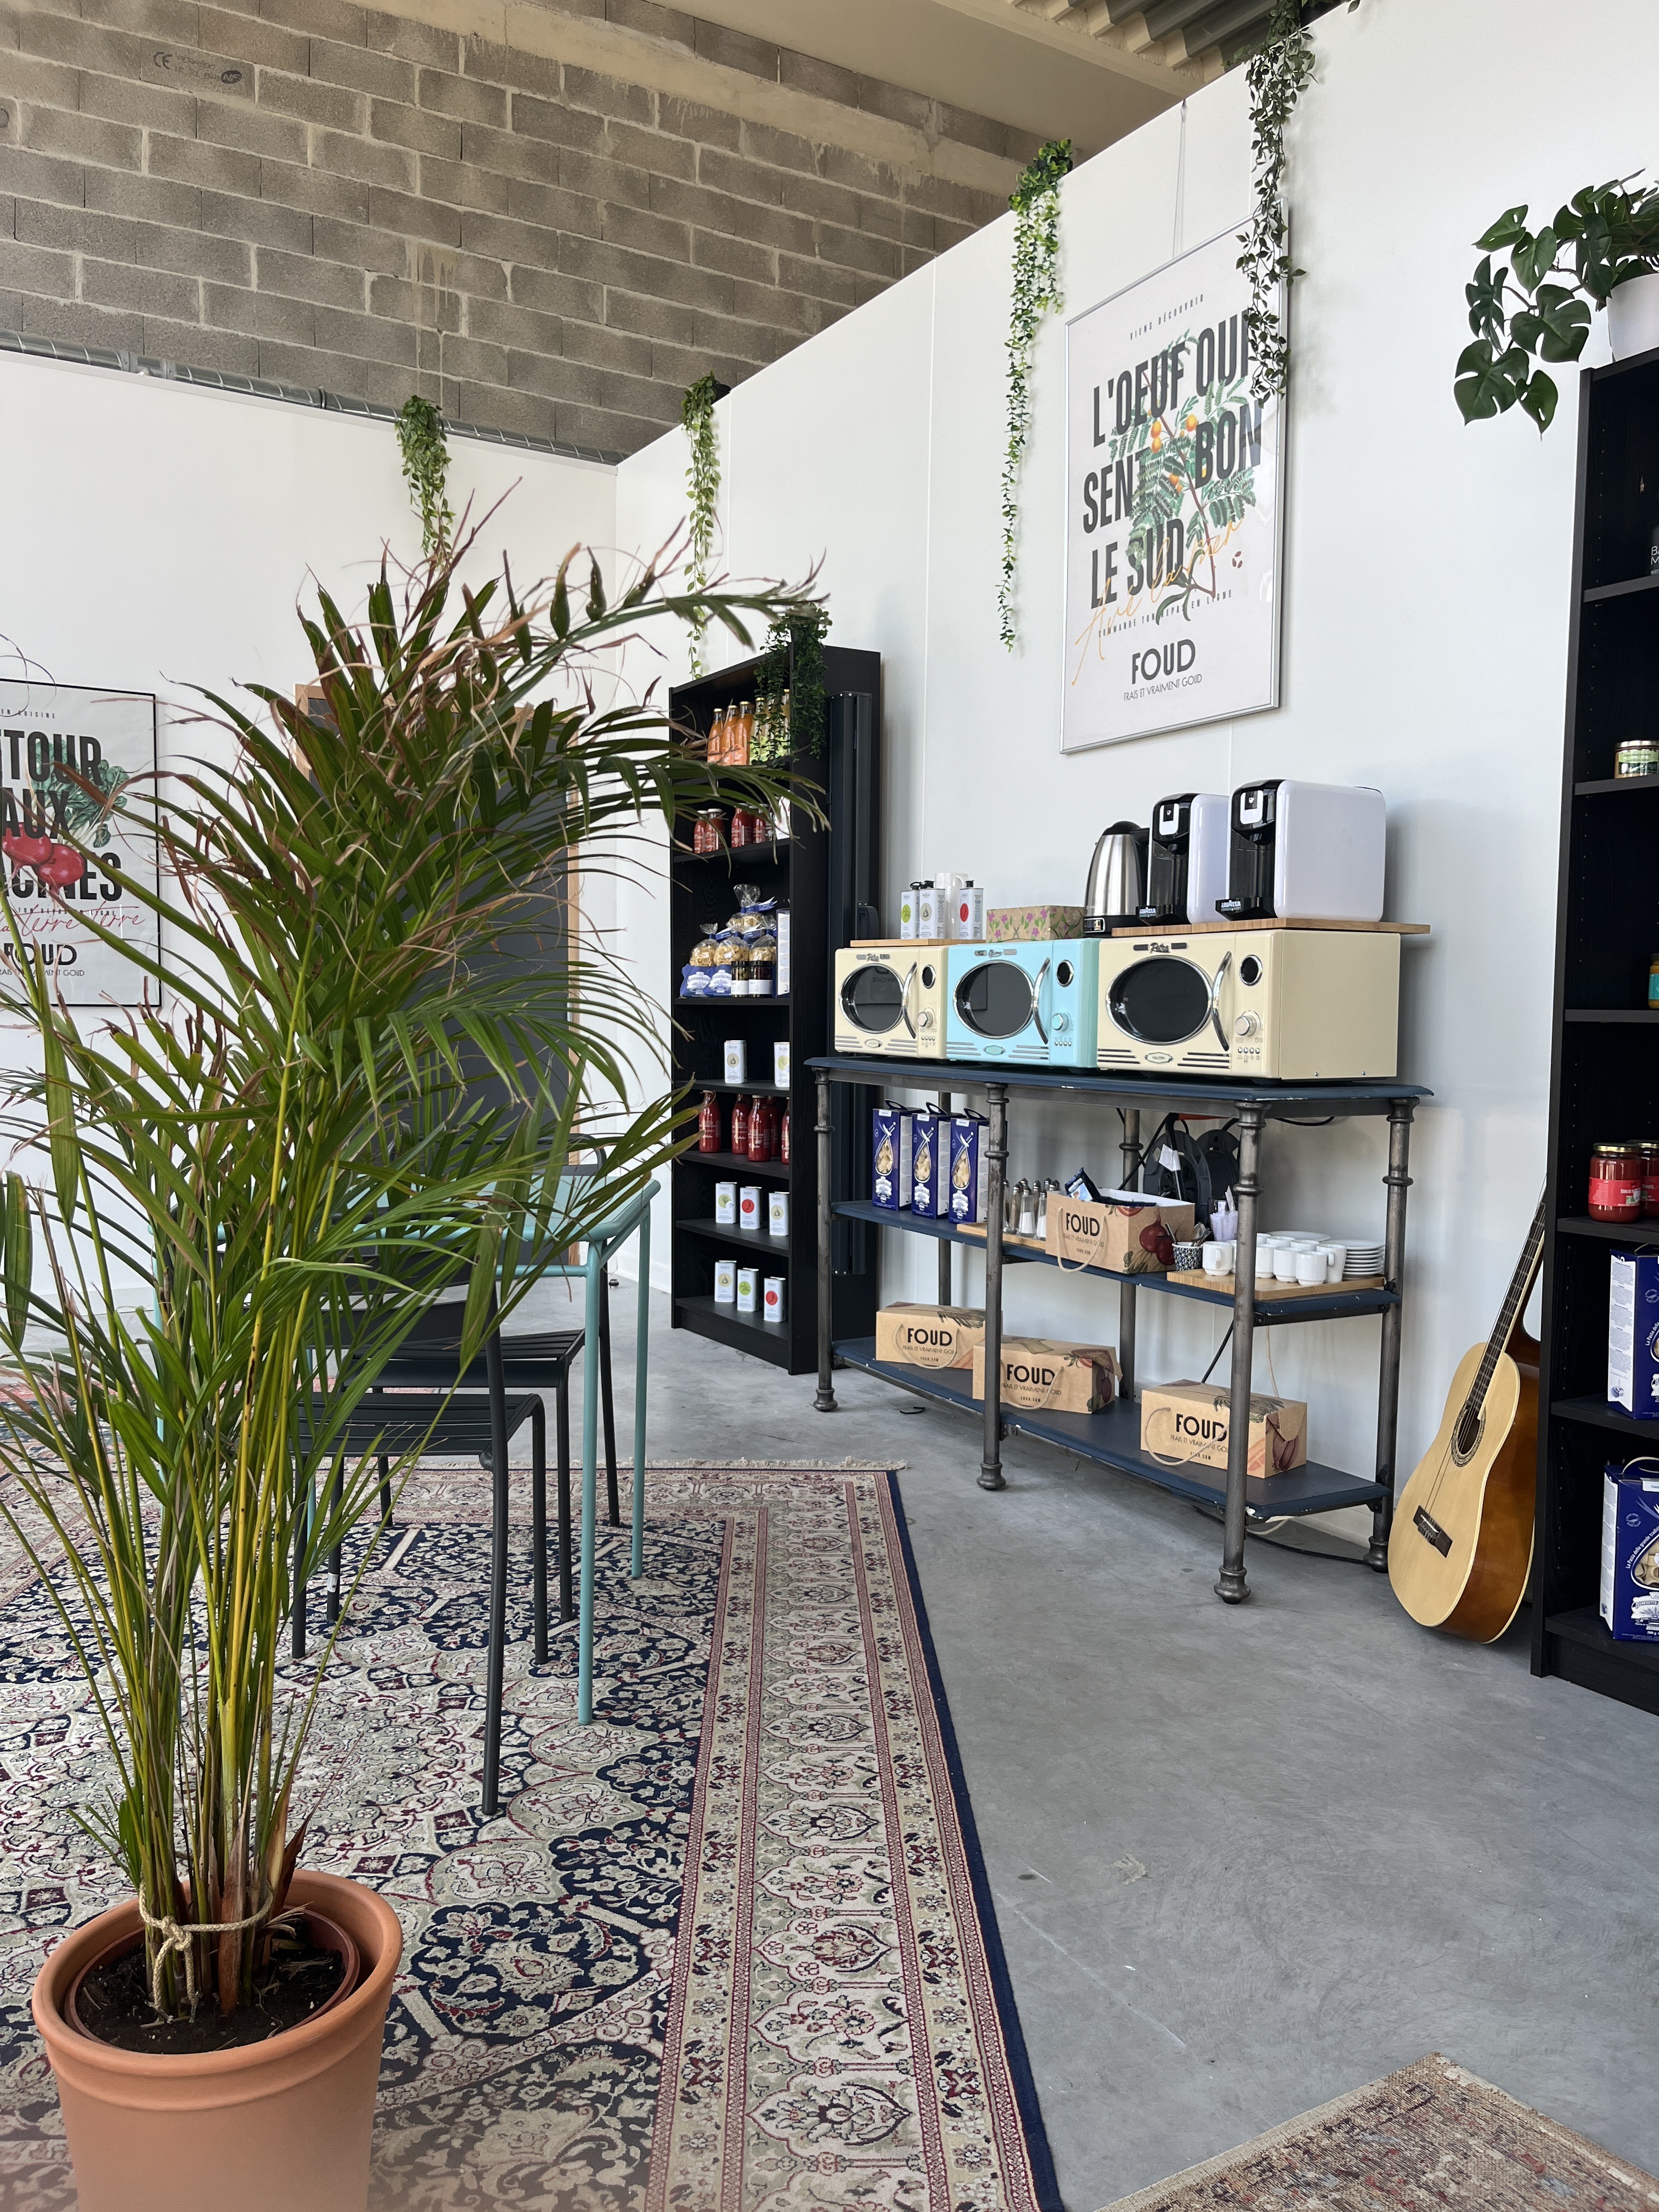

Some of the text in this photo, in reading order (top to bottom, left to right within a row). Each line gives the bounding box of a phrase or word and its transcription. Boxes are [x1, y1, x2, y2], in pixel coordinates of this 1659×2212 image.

[1130, 294, 1204, 340] VIENS DÉCOUVRIR
[1093, 341, 1186, 448] L'OEUF
[1083, 399, 1262, 534] SENT BON
[1091, 518, 1184, 610] LE SUD
[1098, 619, 1137, 638] COMMANDE
[1142, 613, 1155, 624] TON
[1192, 599, 1200, 609] EN
[1207, 589, 1232, 605] LIGNE
[1132, 639, 1196, 685] FOUD
[1124, 674, 1203, 702] FRAIS ET VRAIMENT GOUD
[18, 710, 55, 719] CUISINE
[2, 787, 70, 839] AUX
[1066, 1212, 1100, 1237] FOUD
[907, 1328, 952, 1346] FOUD
[1007, 1363, 1056, 1386] FOUD
[1019, 1385, 1045, 1393] VRAIMENT
[1170, 1434, 1182, 1442] FRAIS
[1176, 1413, 1227, 1442] FOUD
